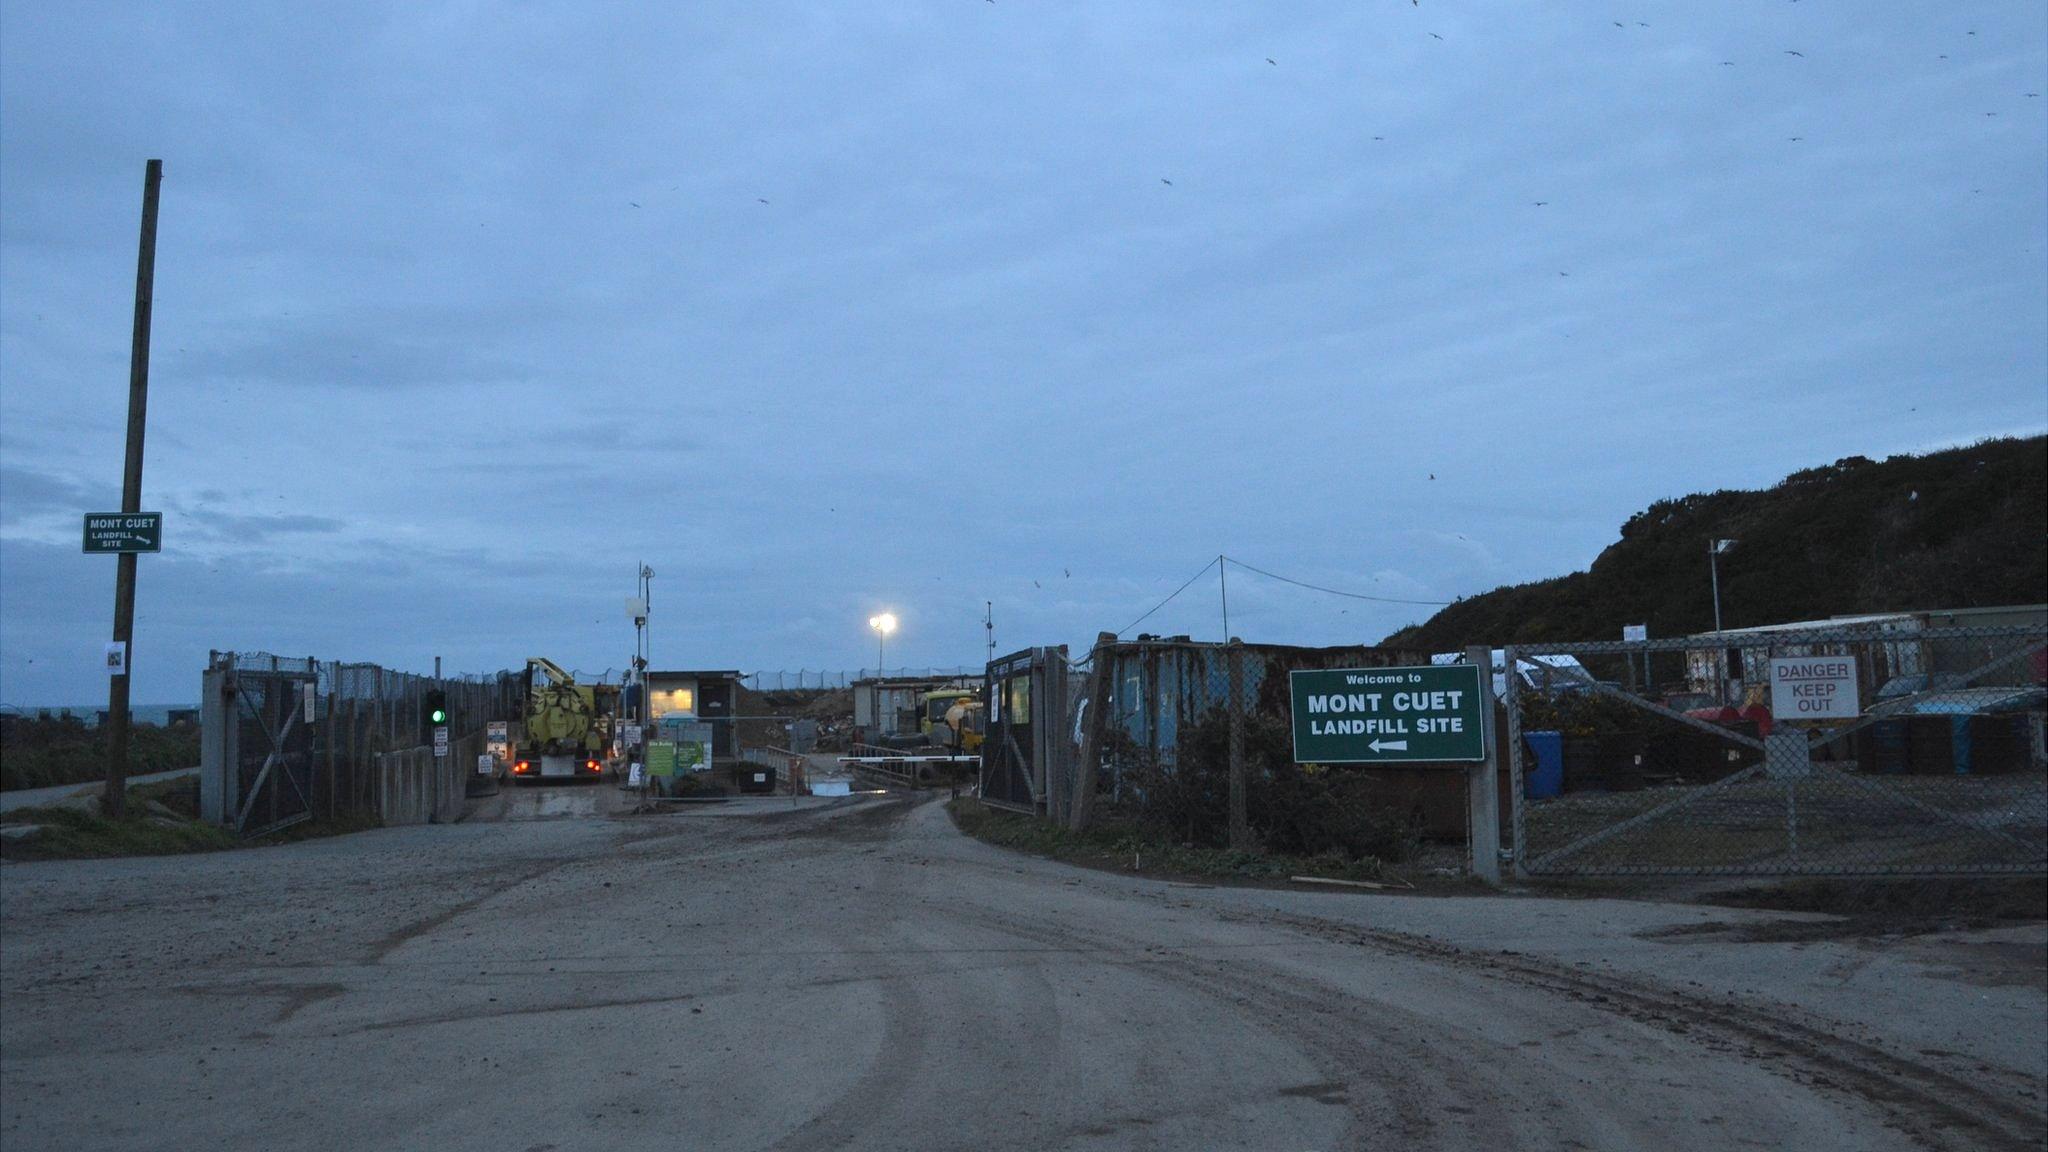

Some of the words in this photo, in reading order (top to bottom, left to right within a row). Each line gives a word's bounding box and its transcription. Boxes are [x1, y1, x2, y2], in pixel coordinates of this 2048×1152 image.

[90, 519, 121, 528] MONT
[126, 518, 155, 528] CUET
[92, 531, 133, 539] LANDFILL
[1778, 663, 1848, 677] DANGER
[1346, 674, 1403, 685] Welcome
[1408, 673, 1422, 683] to
[1792, 683, 1836, 697] KEEP
[1308, 693, 1382, 712] MONT
[1392, 691, 1462, 711] CUET
[1798, 699, 1832, 712] OUT
[1311, 719, 1408, 735] LANDFILL
[1416, 717, 1463, 733] SITE
